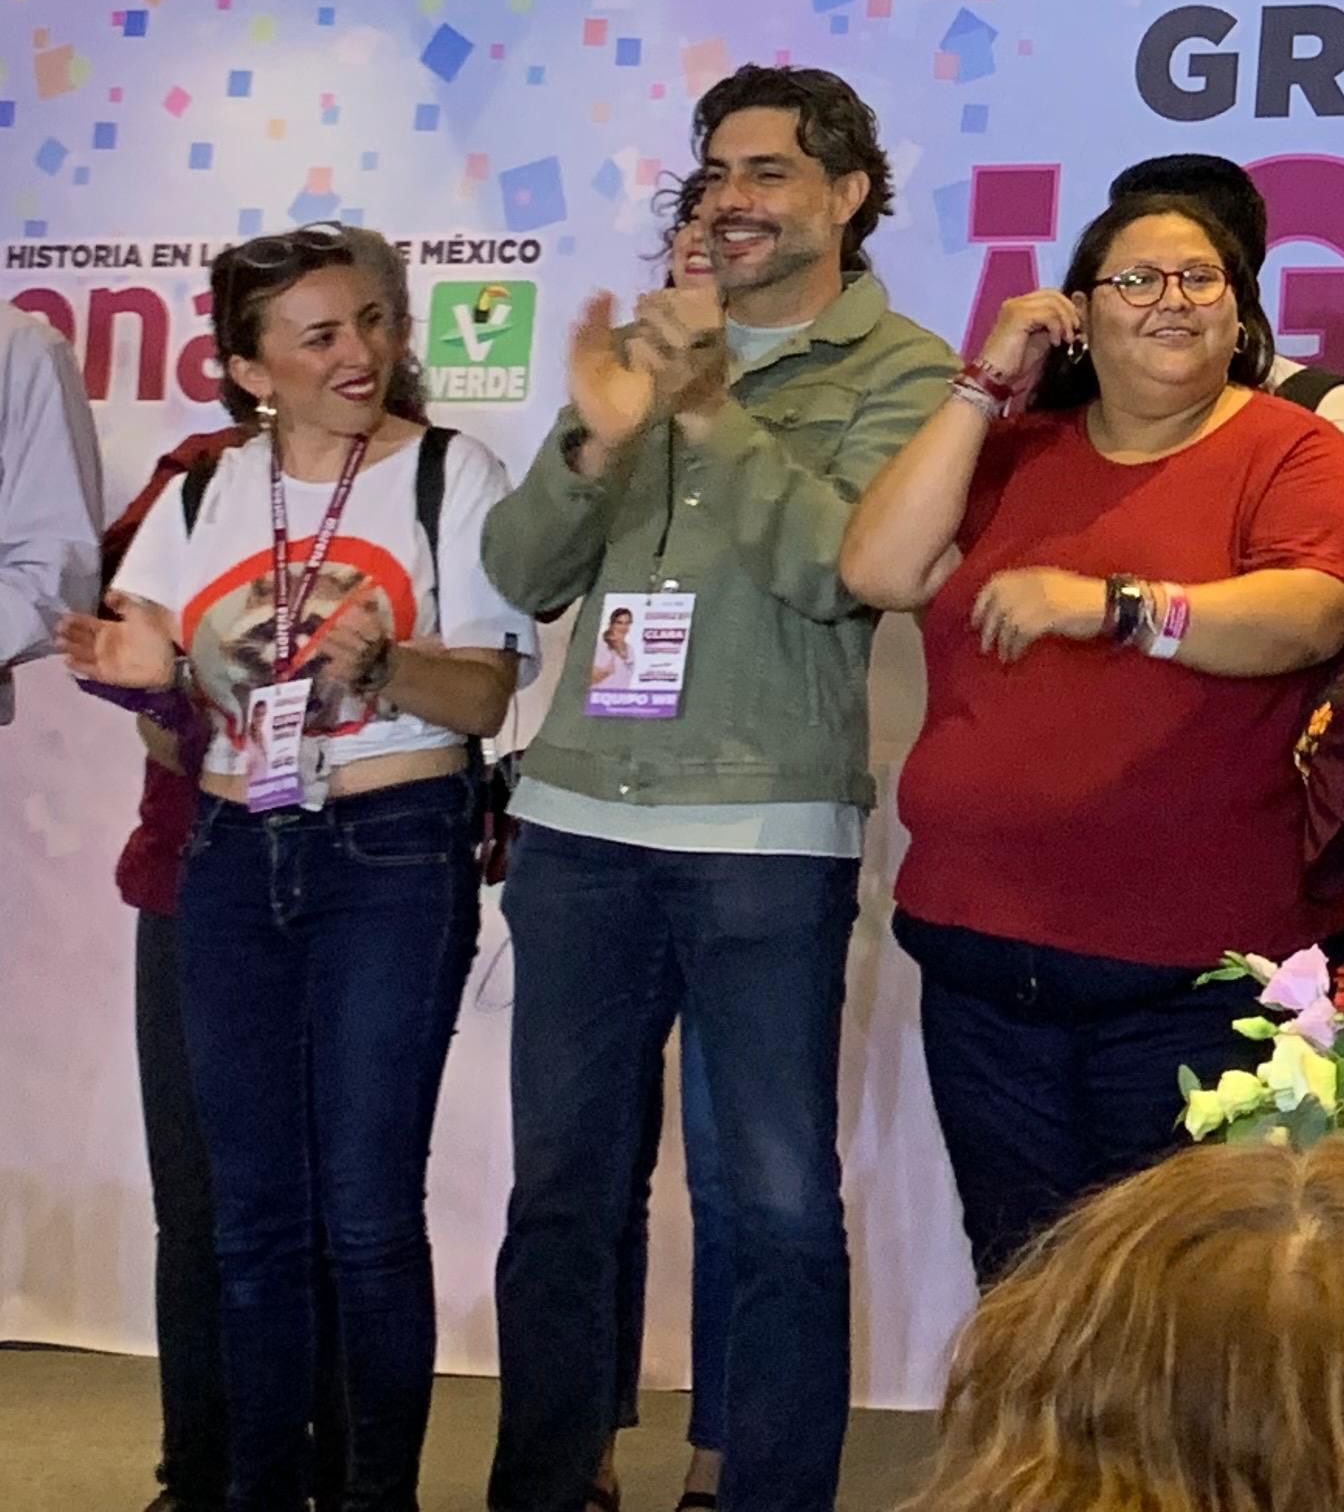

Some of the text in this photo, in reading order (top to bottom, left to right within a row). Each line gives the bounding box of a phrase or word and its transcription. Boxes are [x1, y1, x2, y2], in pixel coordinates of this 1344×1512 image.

[6, 244, 142, 269] HISTORIA
[151, 243, 190, 268] EN
[420, 234, 541, 265] MÉXICO
[430, 367, 526, 399] VERDE
